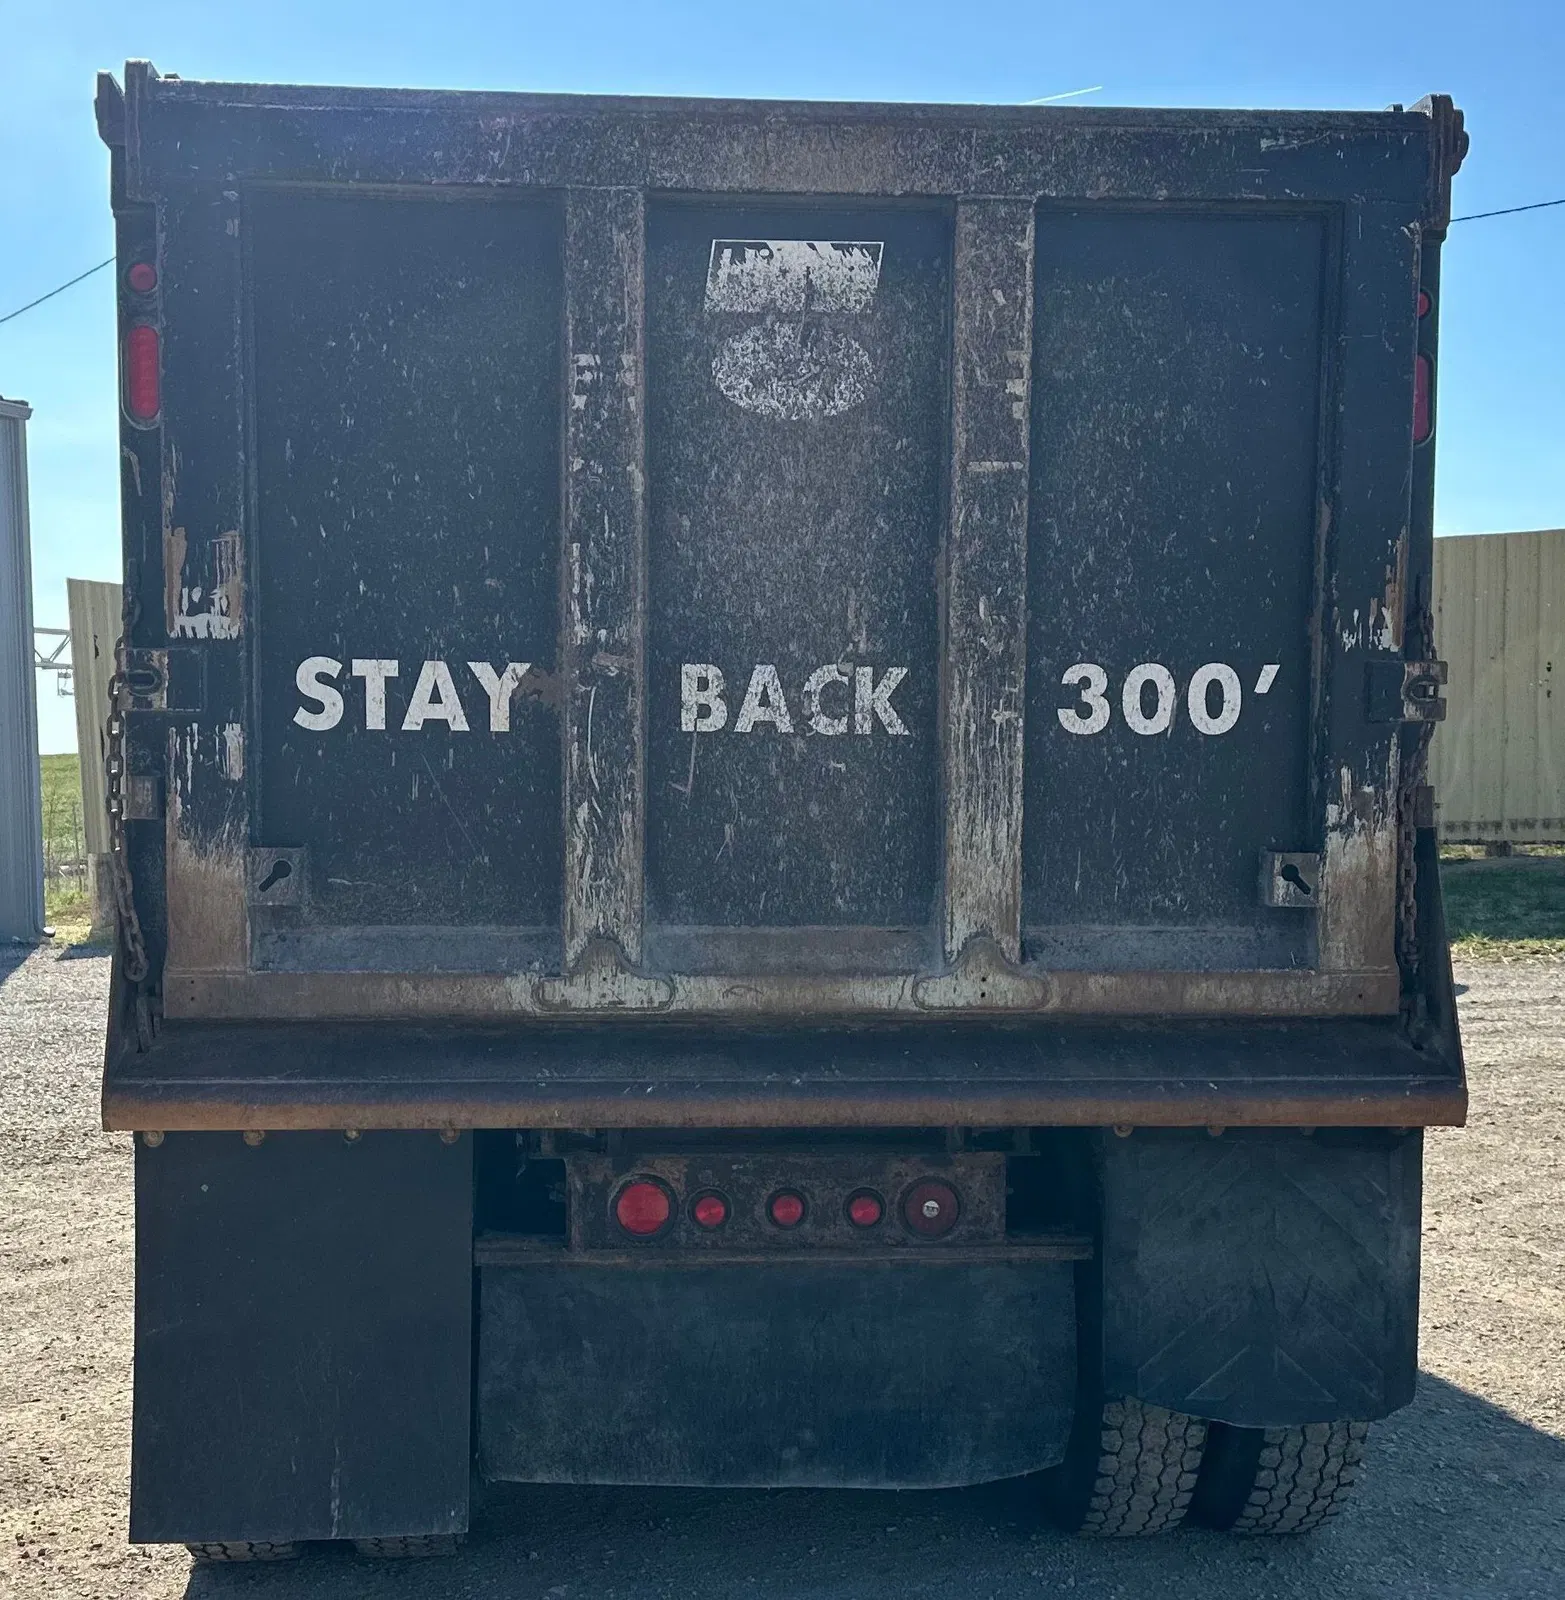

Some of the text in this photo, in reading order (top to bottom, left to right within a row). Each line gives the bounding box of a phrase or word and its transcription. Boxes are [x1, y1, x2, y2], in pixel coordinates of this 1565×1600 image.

[293, 656, 1281, 735] STAY BACK 300'
